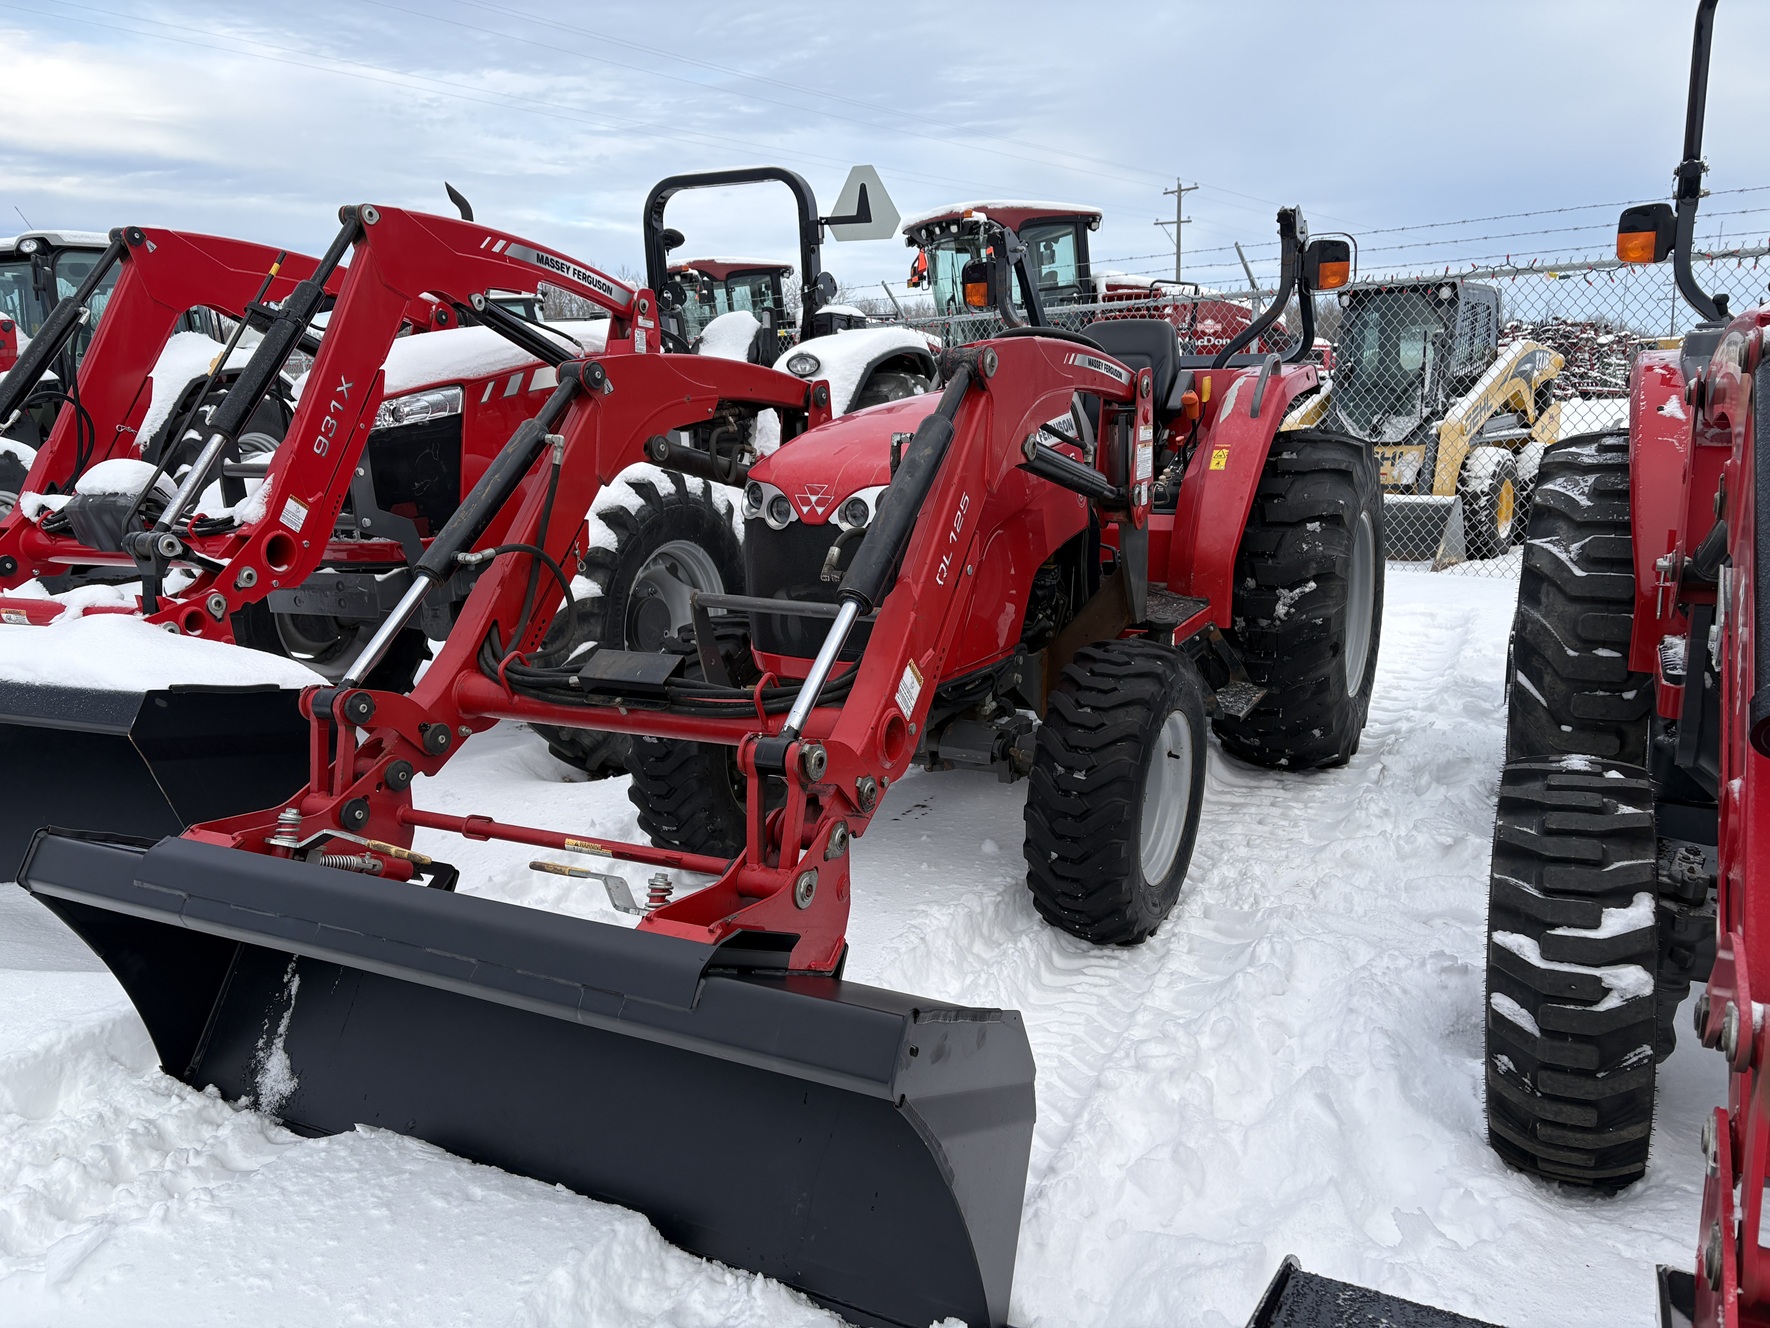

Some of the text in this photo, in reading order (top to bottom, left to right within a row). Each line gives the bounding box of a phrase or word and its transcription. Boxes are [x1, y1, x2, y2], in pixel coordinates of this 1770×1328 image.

[535, 252, 613, 296] MASSEY FERGUSON
[1178, 336, 1231, 347] McDon
[1087, 357, 1123, 381] MASSEY FERGUSON
[313, 374, 354, 457] 931 X
[1038, 417, 1075, 443] FERUSON
[949, 491, 970, 544] 125
